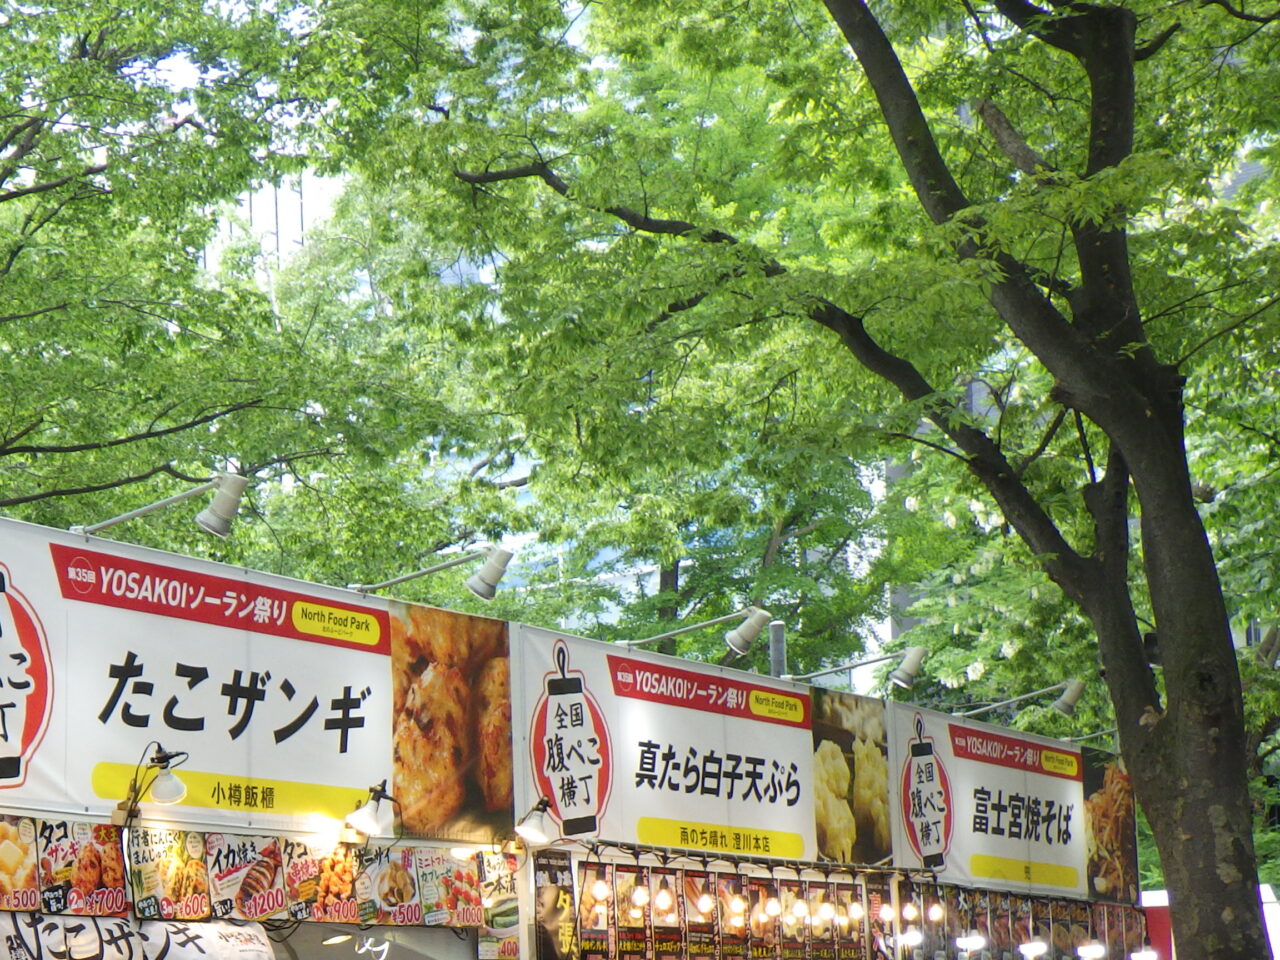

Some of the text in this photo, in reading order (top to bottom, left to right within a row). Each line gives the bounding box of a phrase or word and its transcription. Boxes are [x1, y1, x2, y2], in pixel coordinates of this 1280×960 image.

[67, 564, 287, 627] 第35回 YOSAKOIソーラン祭り
[300, 606, 370, 632] North Food Park
[98, 650, 373, 755] たこザンギ
[634, 668, 747, 711] YOSAKOIソーラン祭り
[754, 695, 769, 706] North
[768, 698, 784, 709] Food
[784, 701, 799, 712] Park
[553, 701, 584, 731] 全国
[545, 732, 601, 774] 腹ぺこ
[966, 735, 1041, 768] YOSAKOIソーラン祭り
[635, 739, 801, 808] 真たら白子天ぷら
[915, 762, 934, 785] 全国
[210, 781, 276, 810] 小樽飯櫃
[558, 775, 594, 810] 横丁
[911, 786, 947, 820] 腹ぺこ
[972, 785, 1075, 846] 富士宮焼そば
[39, 820, 69, 852] タコ
[679, 826, 771, 852] 雨のち晴れ 澄川本店
[919, 820, 942, 847] 横丁
[47, 840, 80, 864] ザンギ
[210, 840, 257, 873] イカ焼き
[483, 873, 517, 896] 一本漬
[86, 887, 125, 915] ¥700
[245, 887, 285, 919] ¥1200
[392, 903, 421, 925] ¥500
